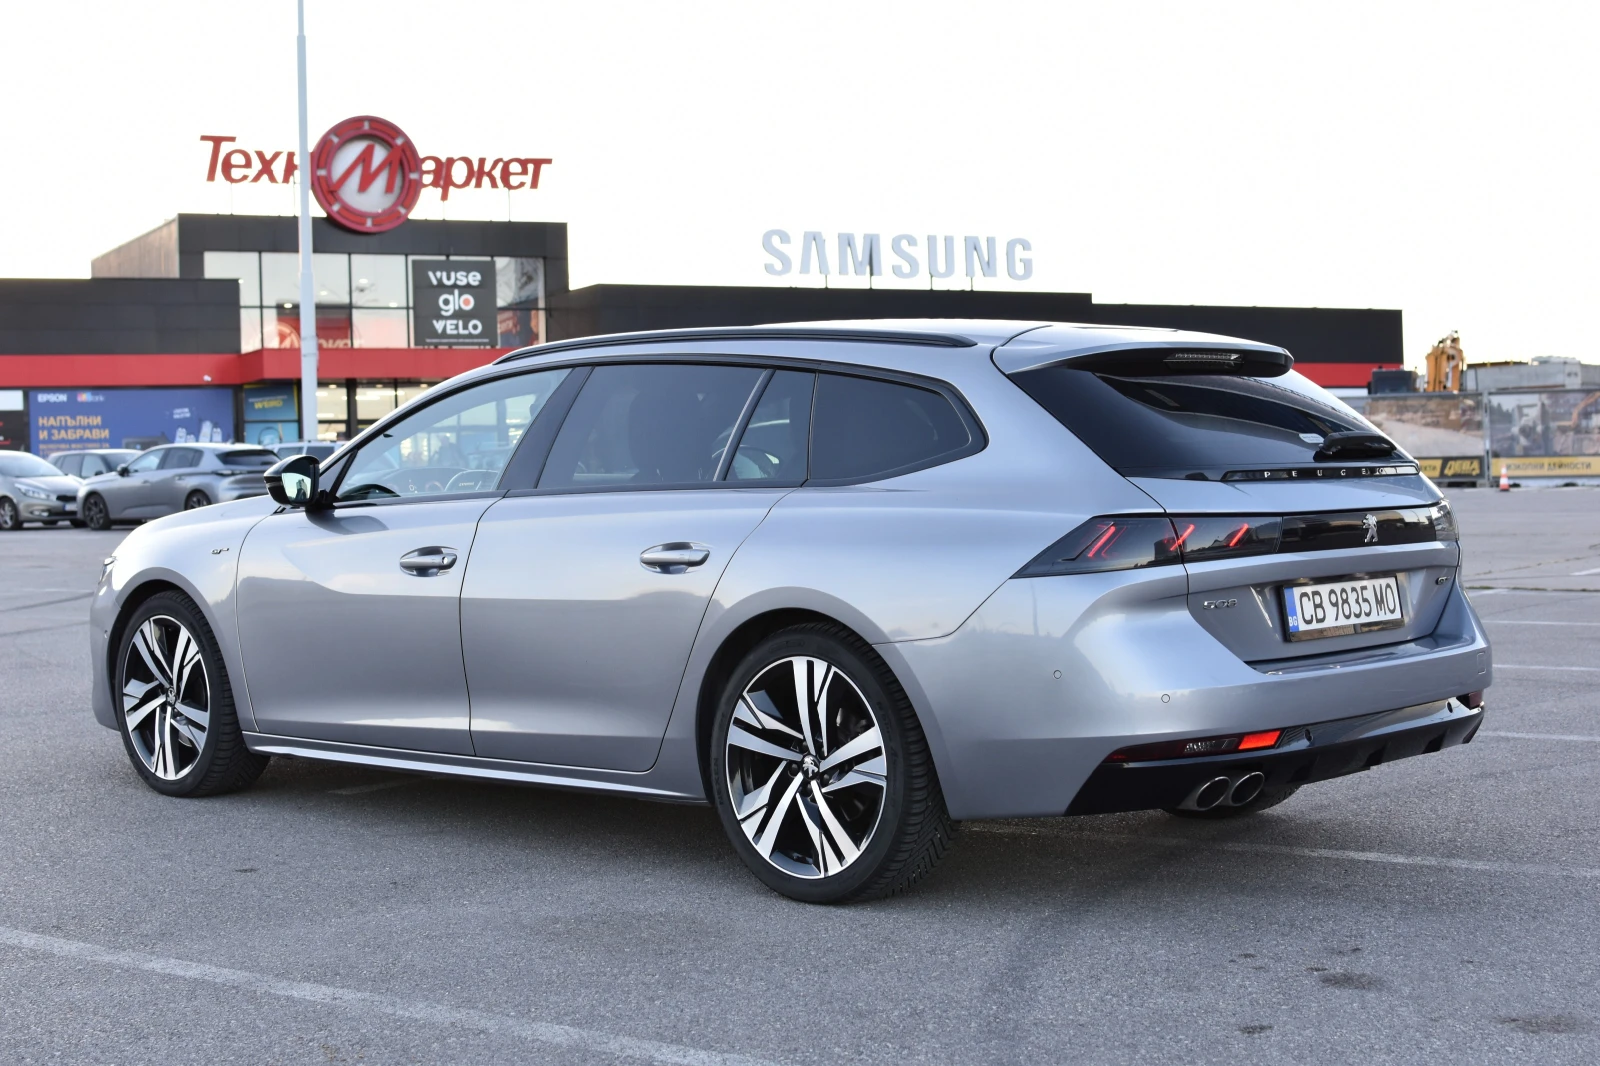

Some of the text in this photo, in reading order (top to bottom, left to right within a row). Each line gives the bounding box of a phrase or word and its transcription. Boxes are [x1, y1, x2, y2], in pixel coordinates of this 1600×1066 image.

[762, 229, 1033, 281] SAMSUNG
[438, 289, 474, 316] glo
[432, 320, 482, 334] VELO
[38, 393, 67, 402] EPSON
[38, 415, 102, 427] НАПЪЛНИ
[51, 428, 109, 441] ЗАБРАВИ
[1264, 467, 1396, 479] PEUGEO
[1203, 598, 1238, 609] 508
[1299, 582, 1397, 625] CB 9835 MO
